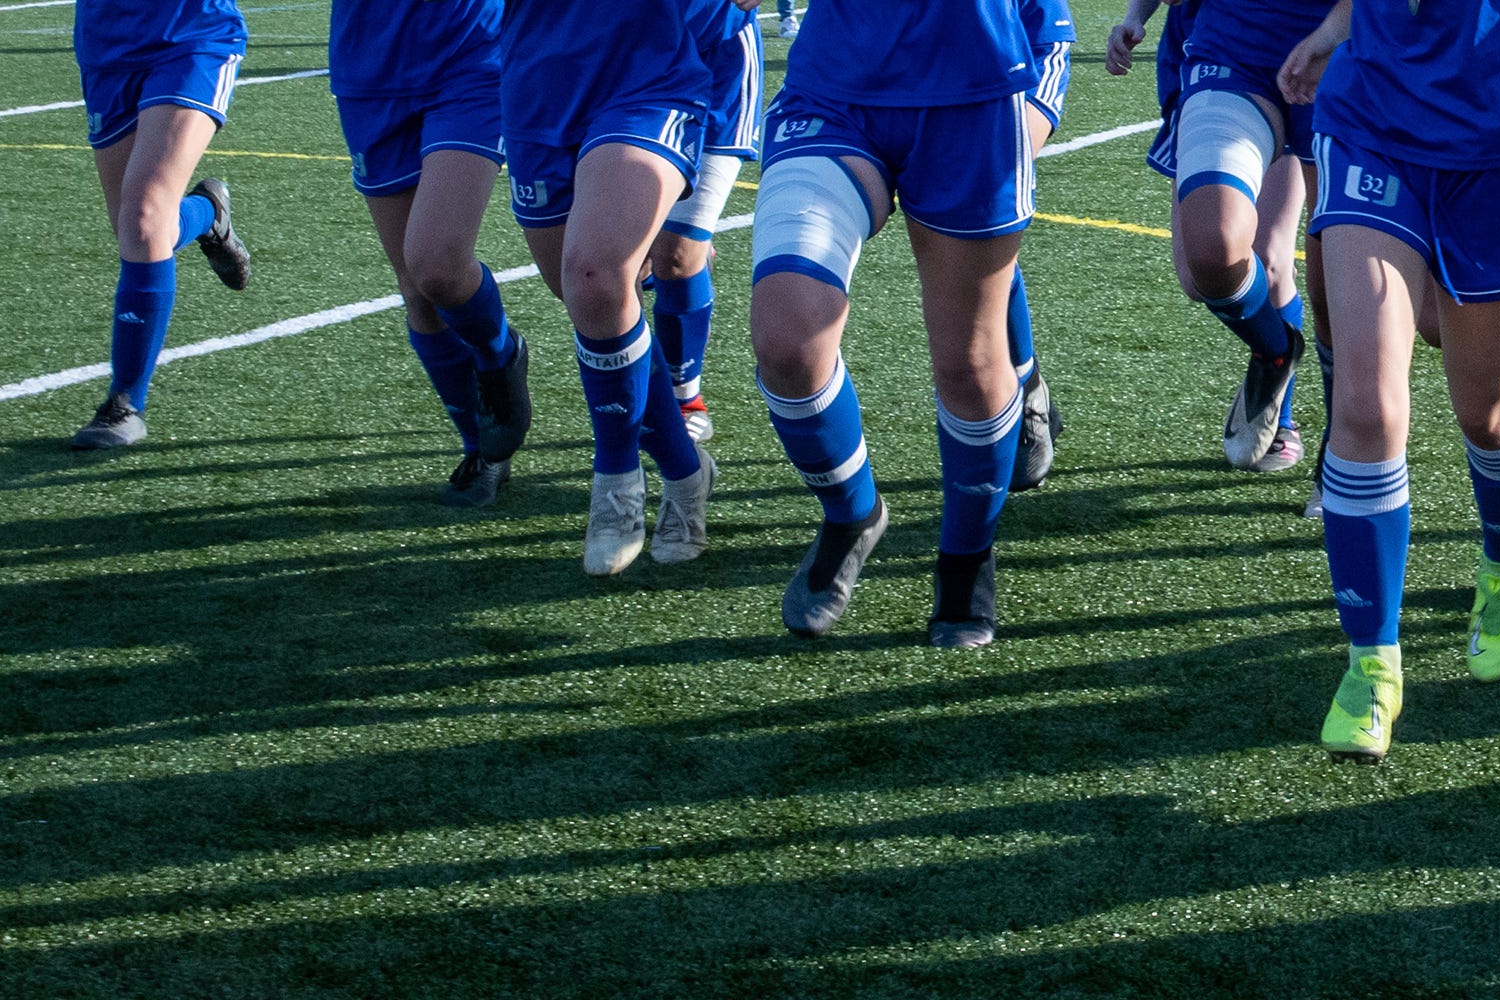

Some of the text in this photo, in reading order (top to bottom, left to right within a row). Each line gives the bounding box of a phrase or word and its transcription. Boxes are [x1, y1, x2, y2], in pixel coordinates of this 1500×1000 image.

[1199, 64, 1218, 79] 32
[785, 120, 807, 133] 32
[518, 184, 534, 199] 32
[1361, 174, 1384, 194] 32
